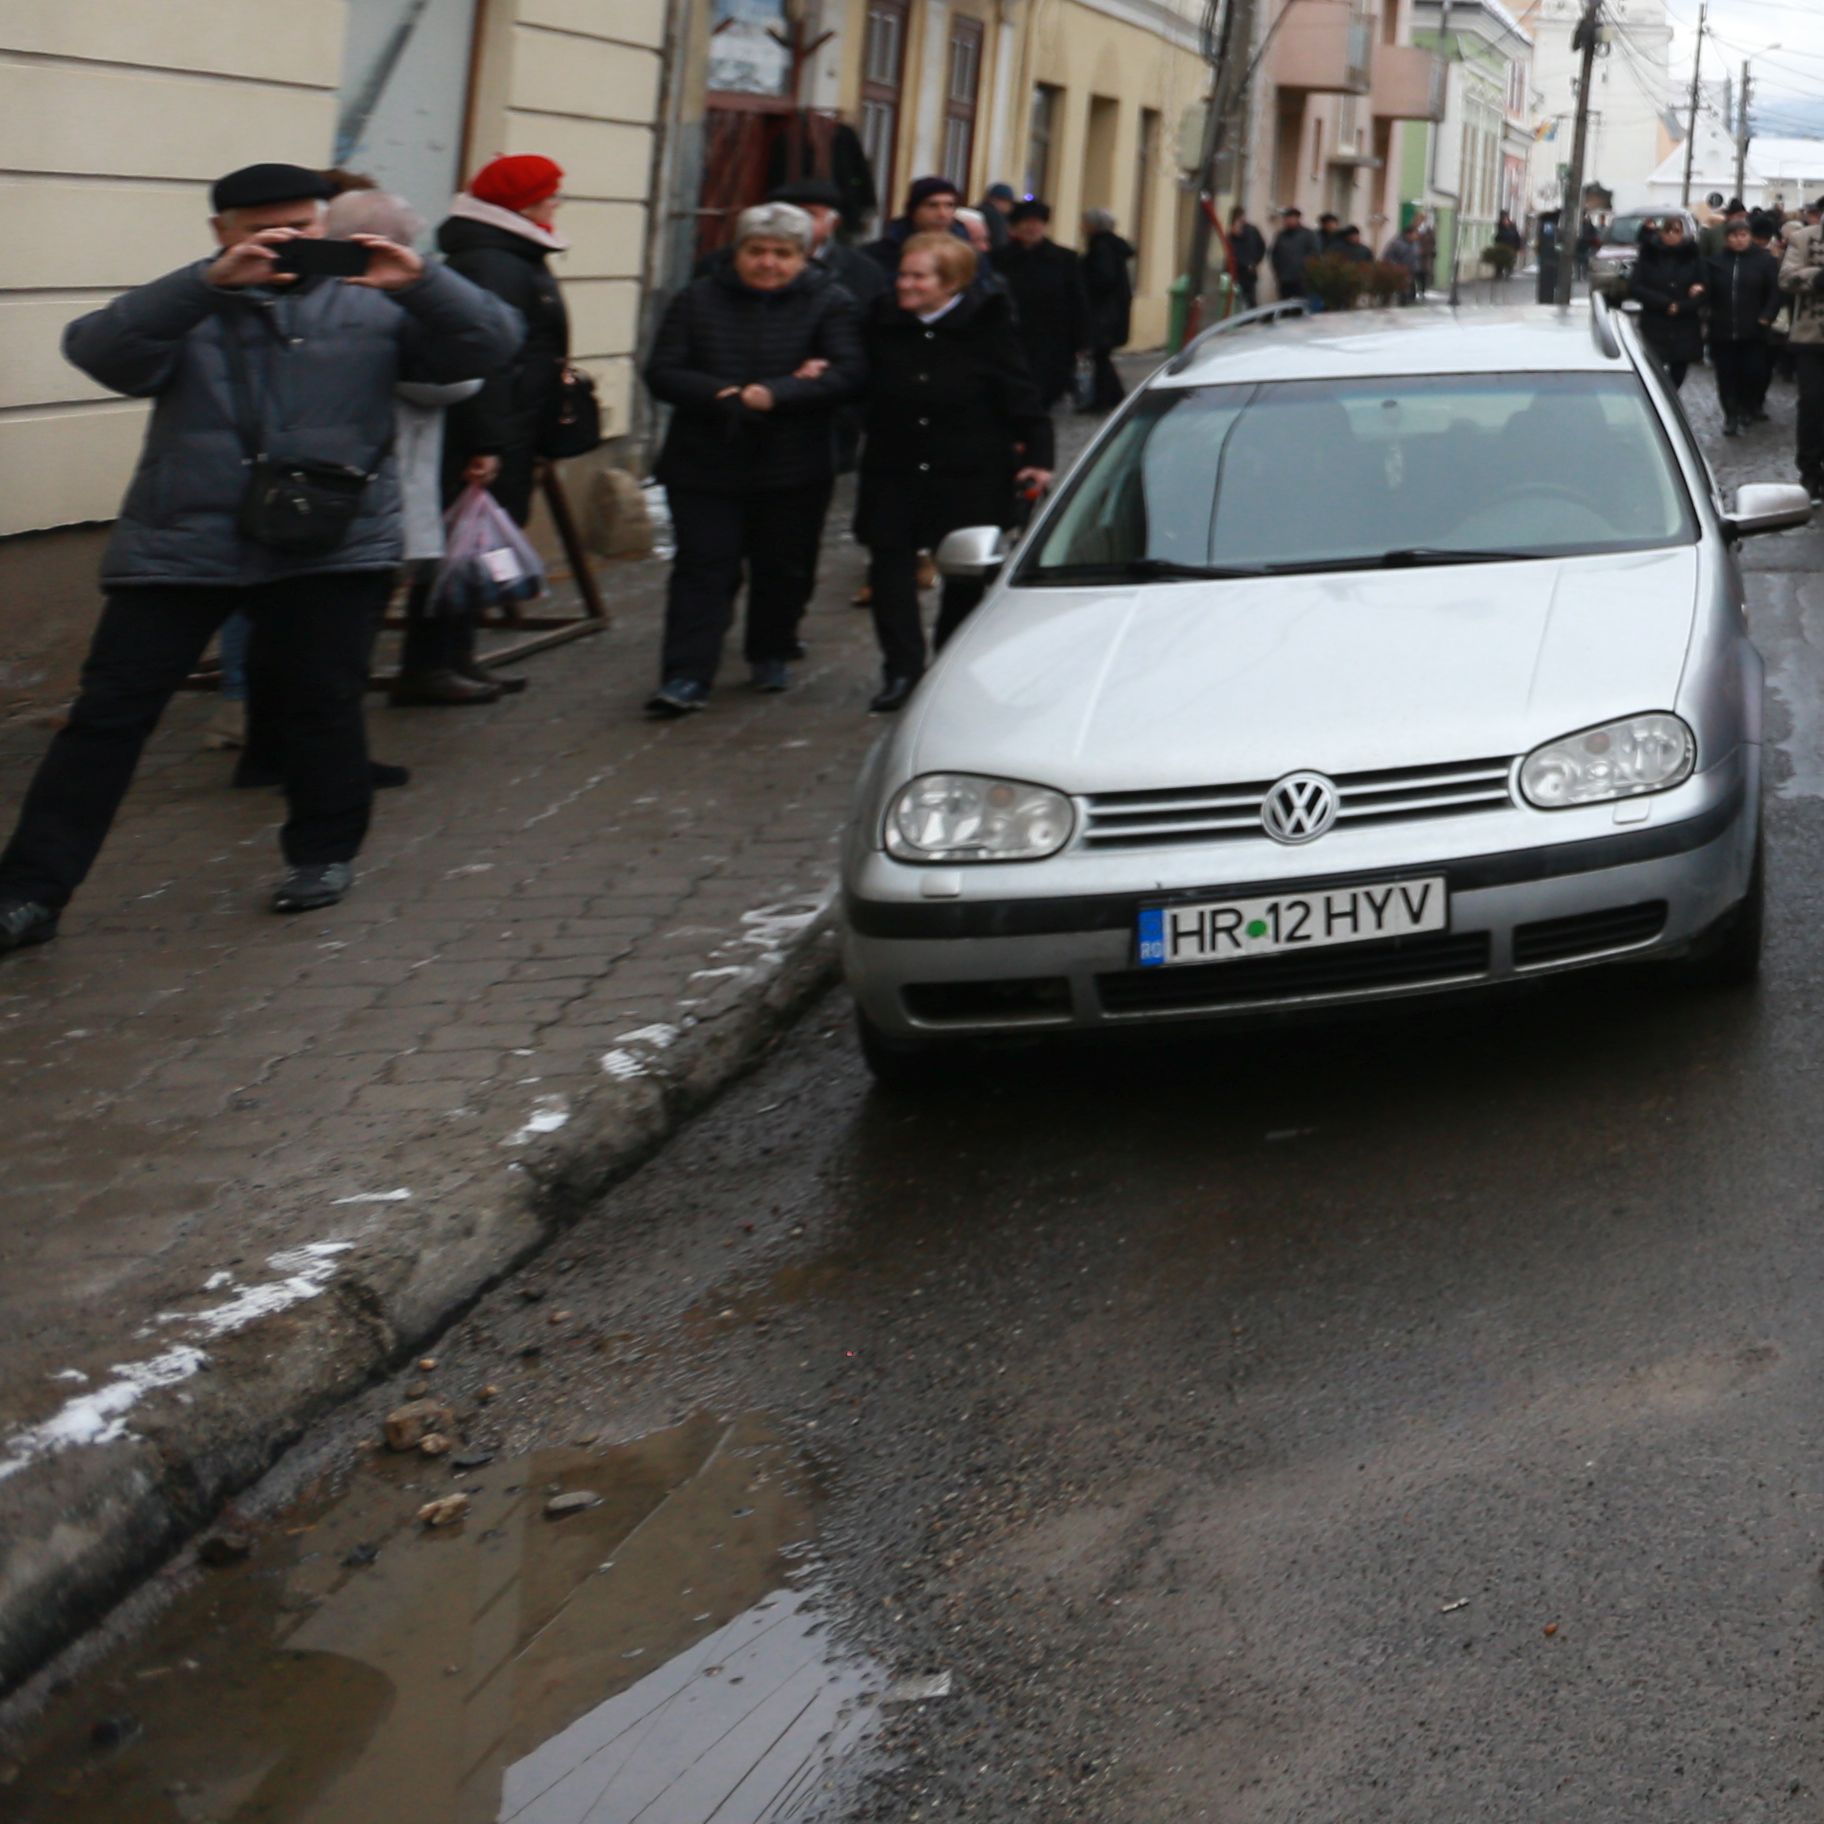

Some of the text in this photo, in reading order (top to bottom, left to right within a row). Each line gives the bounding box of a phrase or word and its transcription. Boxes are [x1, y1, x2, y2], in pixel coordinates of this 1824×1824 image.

[1170, 882, 1431, 956] HR 12 HYV
